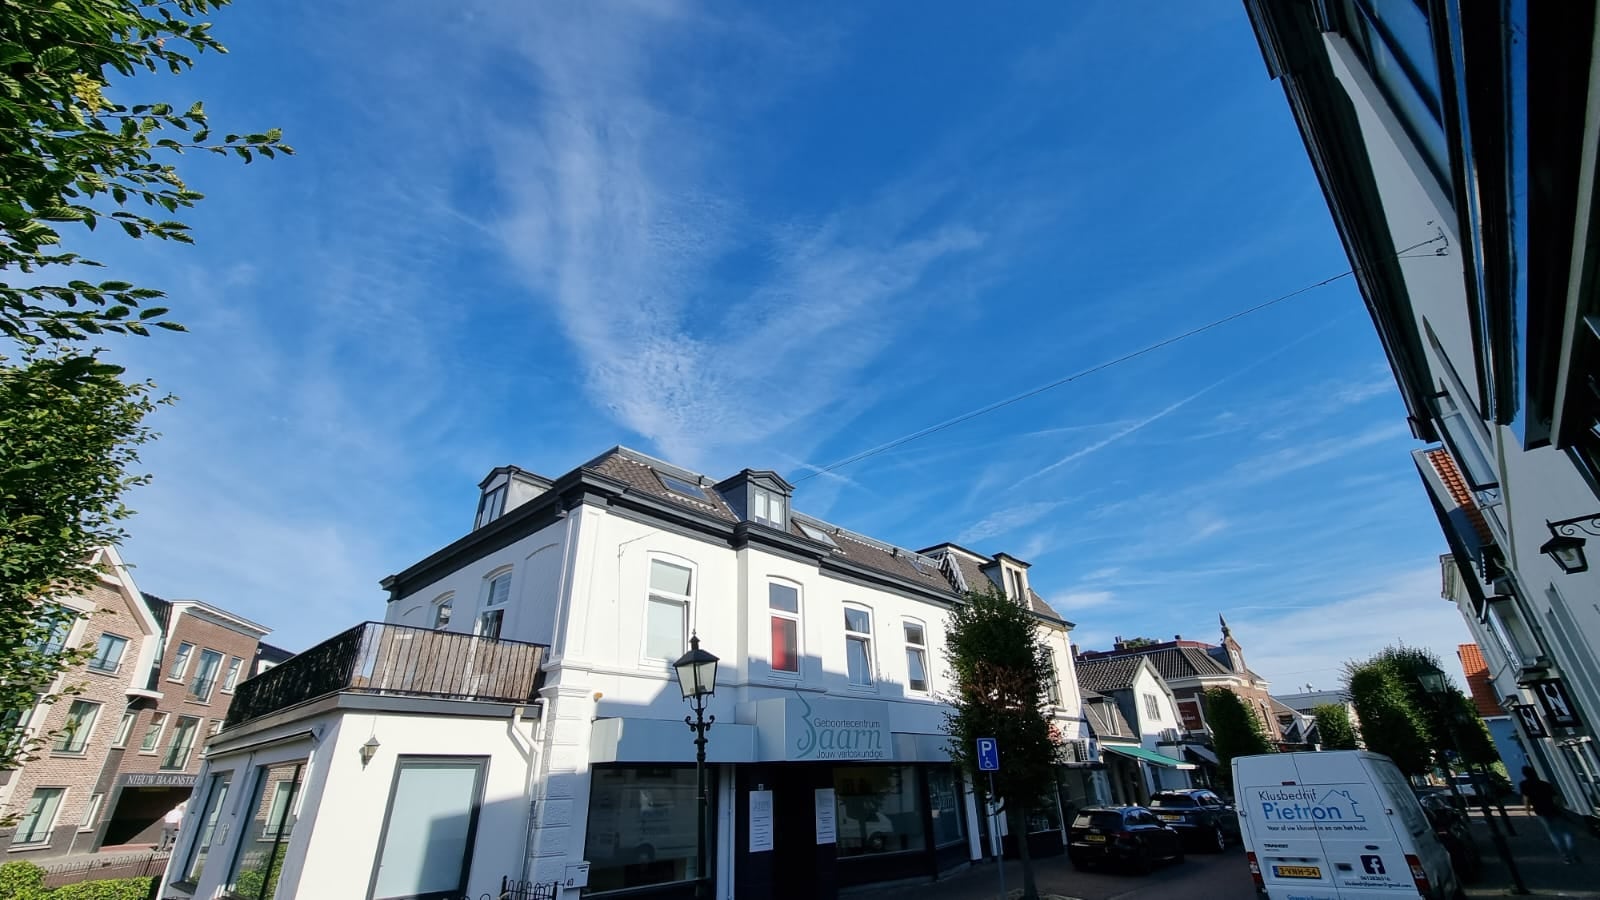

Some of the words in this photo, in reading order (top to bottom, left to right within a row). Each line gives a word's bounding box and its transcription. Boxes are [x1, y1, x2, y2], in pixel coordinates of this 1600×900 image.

[814, 717, 880, 729] Geboortecentrum
[816, 748, 835, 759] Jouw
[982, 741, 992, 757] P
[127, 775, 156, 785] NIEUW
[1258, 788, 1316, 802] Klusbedrijf
[1262, 802, 1342, 820] Pietron
